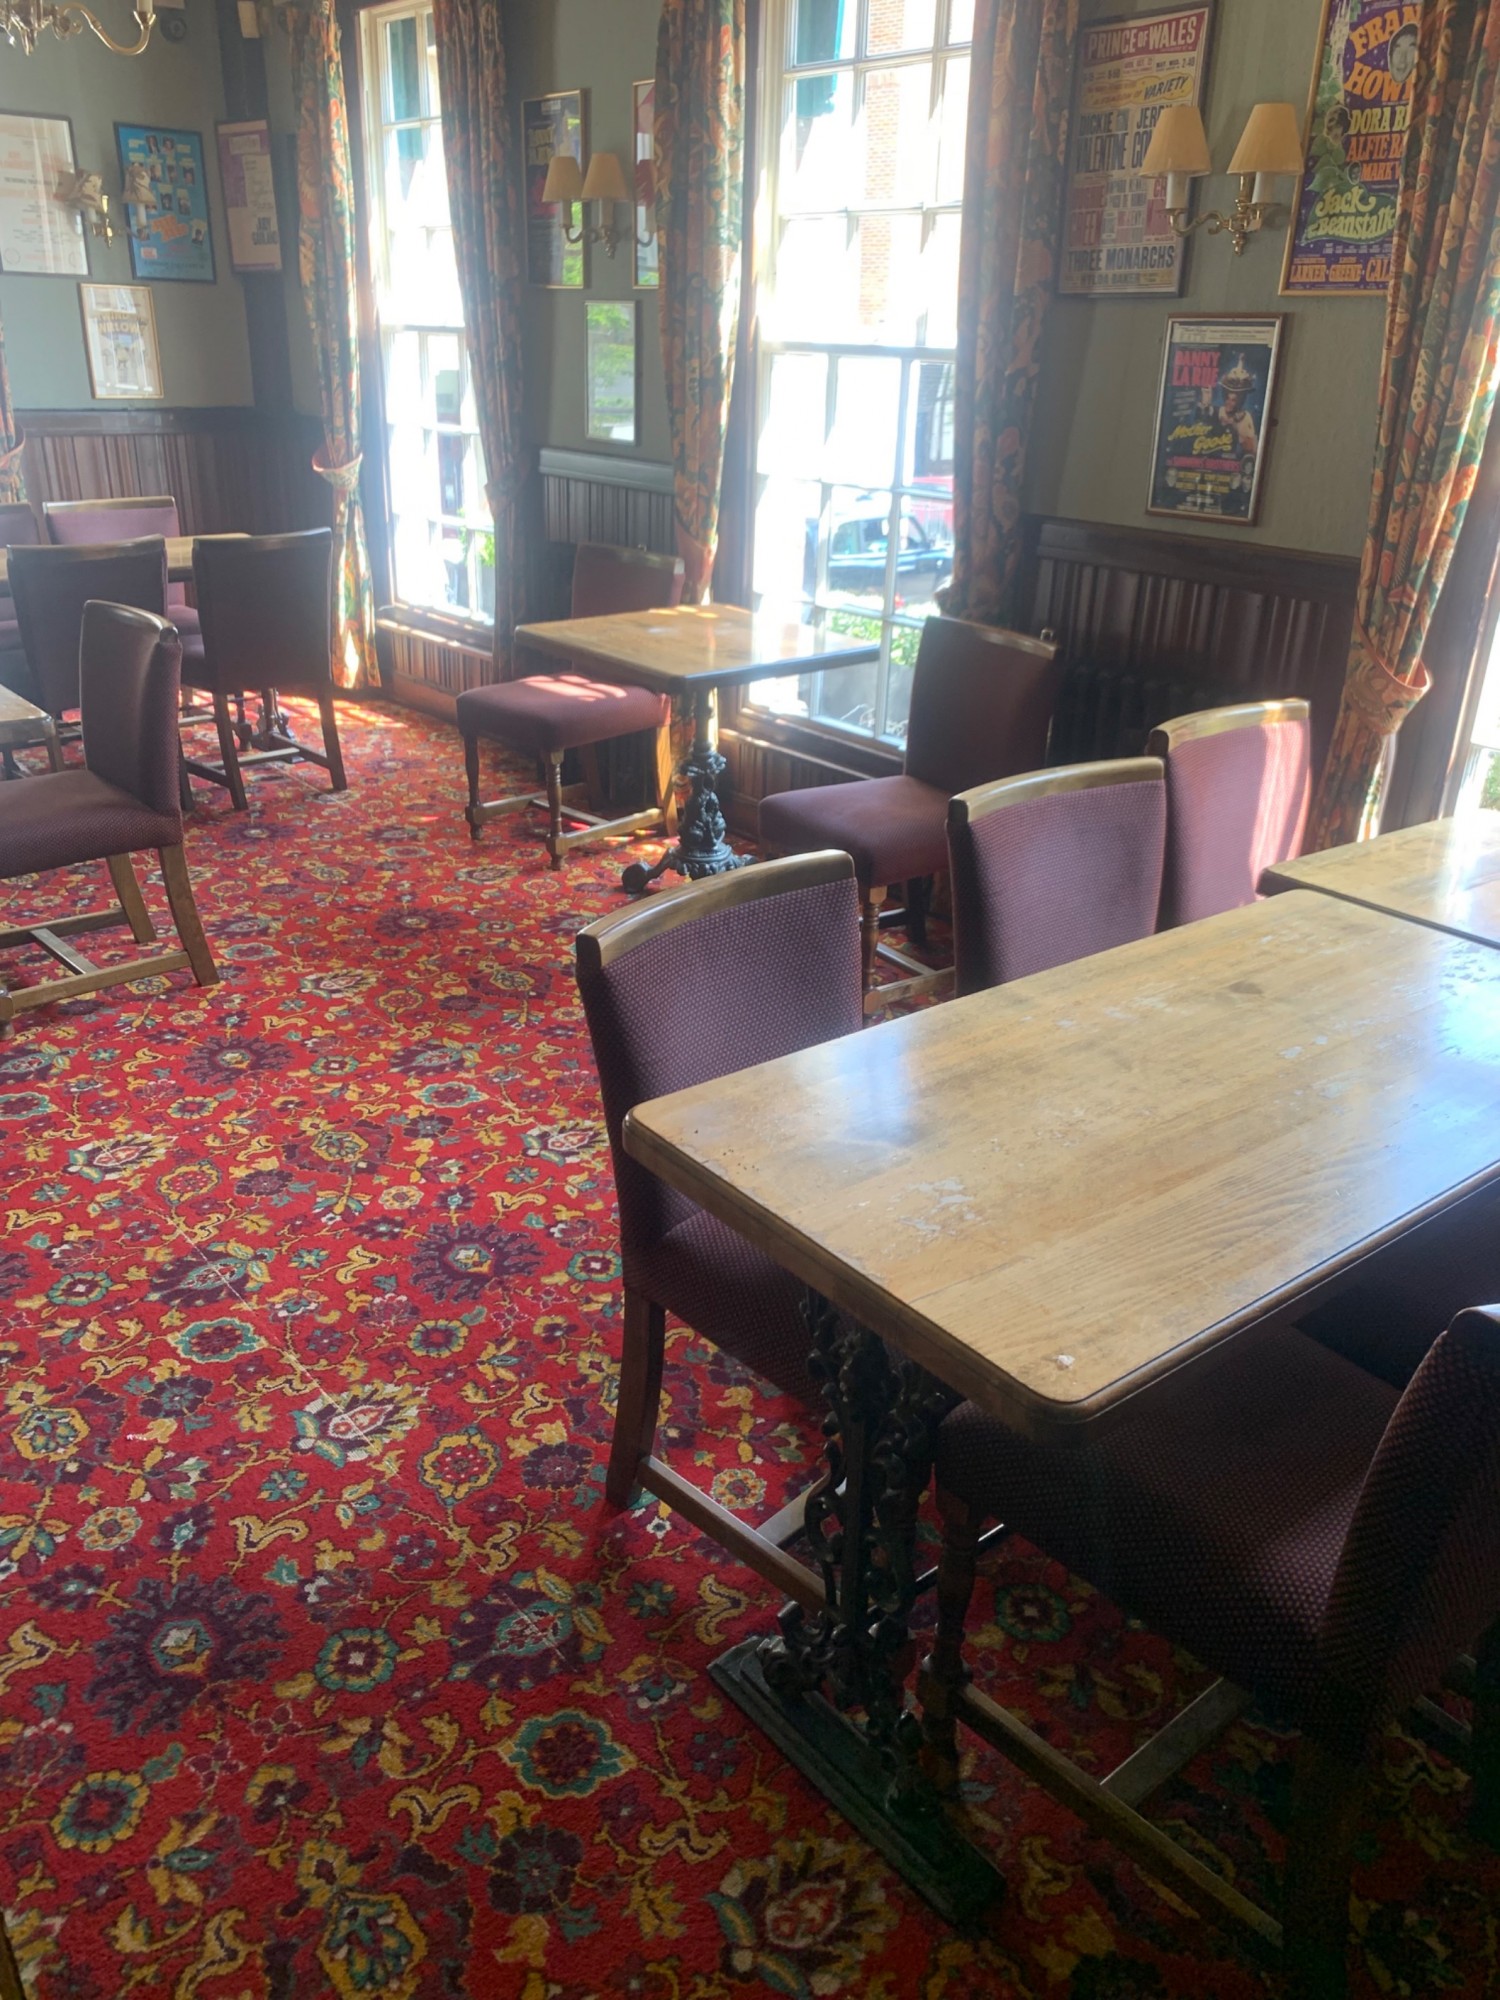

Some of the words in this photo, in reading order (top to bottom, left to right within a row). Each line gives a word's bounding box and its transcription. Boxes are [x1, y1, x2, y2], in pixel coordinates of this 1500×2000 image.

[1087, 29, 1137, 60] PRINCE
[1137, 30, 1149, 48] OF
[1149, 16, 1197, 50] WALES
[1143, 75, 1190, 101] VARIETY
[1348, 107, 1391, 135] DORA
[1346, 134, 1390, 161] ALFIE
[1360, 162, 1393, 182] MARK
[1315, 185, 1377, 217] Jack
[1067, 249, 1103, 273] THREE
[1105, 245, 1176, 272] MONARCHS
